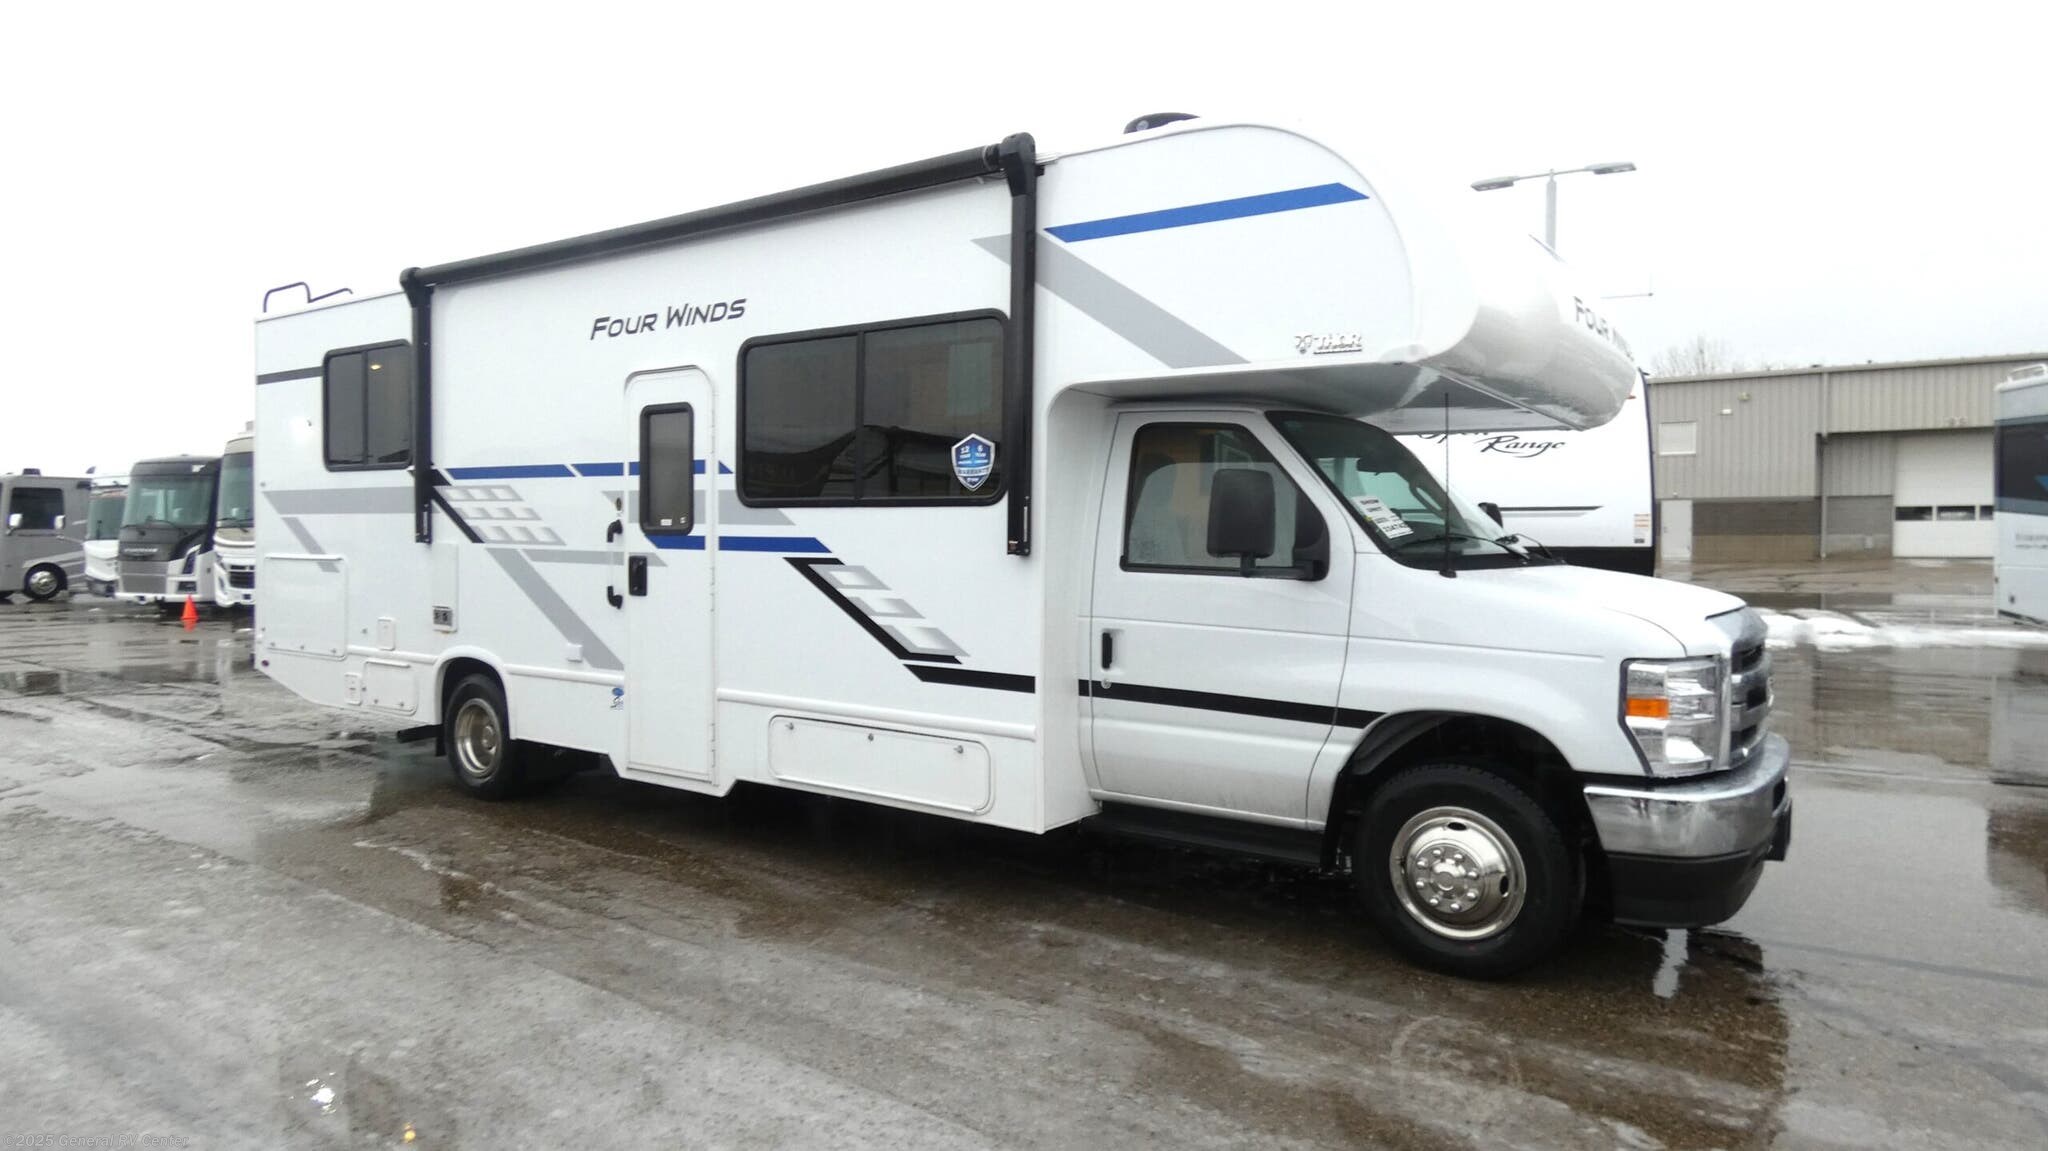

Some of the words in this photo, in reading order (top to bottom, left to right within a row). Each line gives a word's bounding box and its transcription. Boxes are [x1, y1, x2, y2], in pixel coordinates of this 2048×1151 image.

[590, 313, 658, 340] FOUR
[666, 298, 747, 329] WINDS
[1474, 435, 1566, 458] Range
